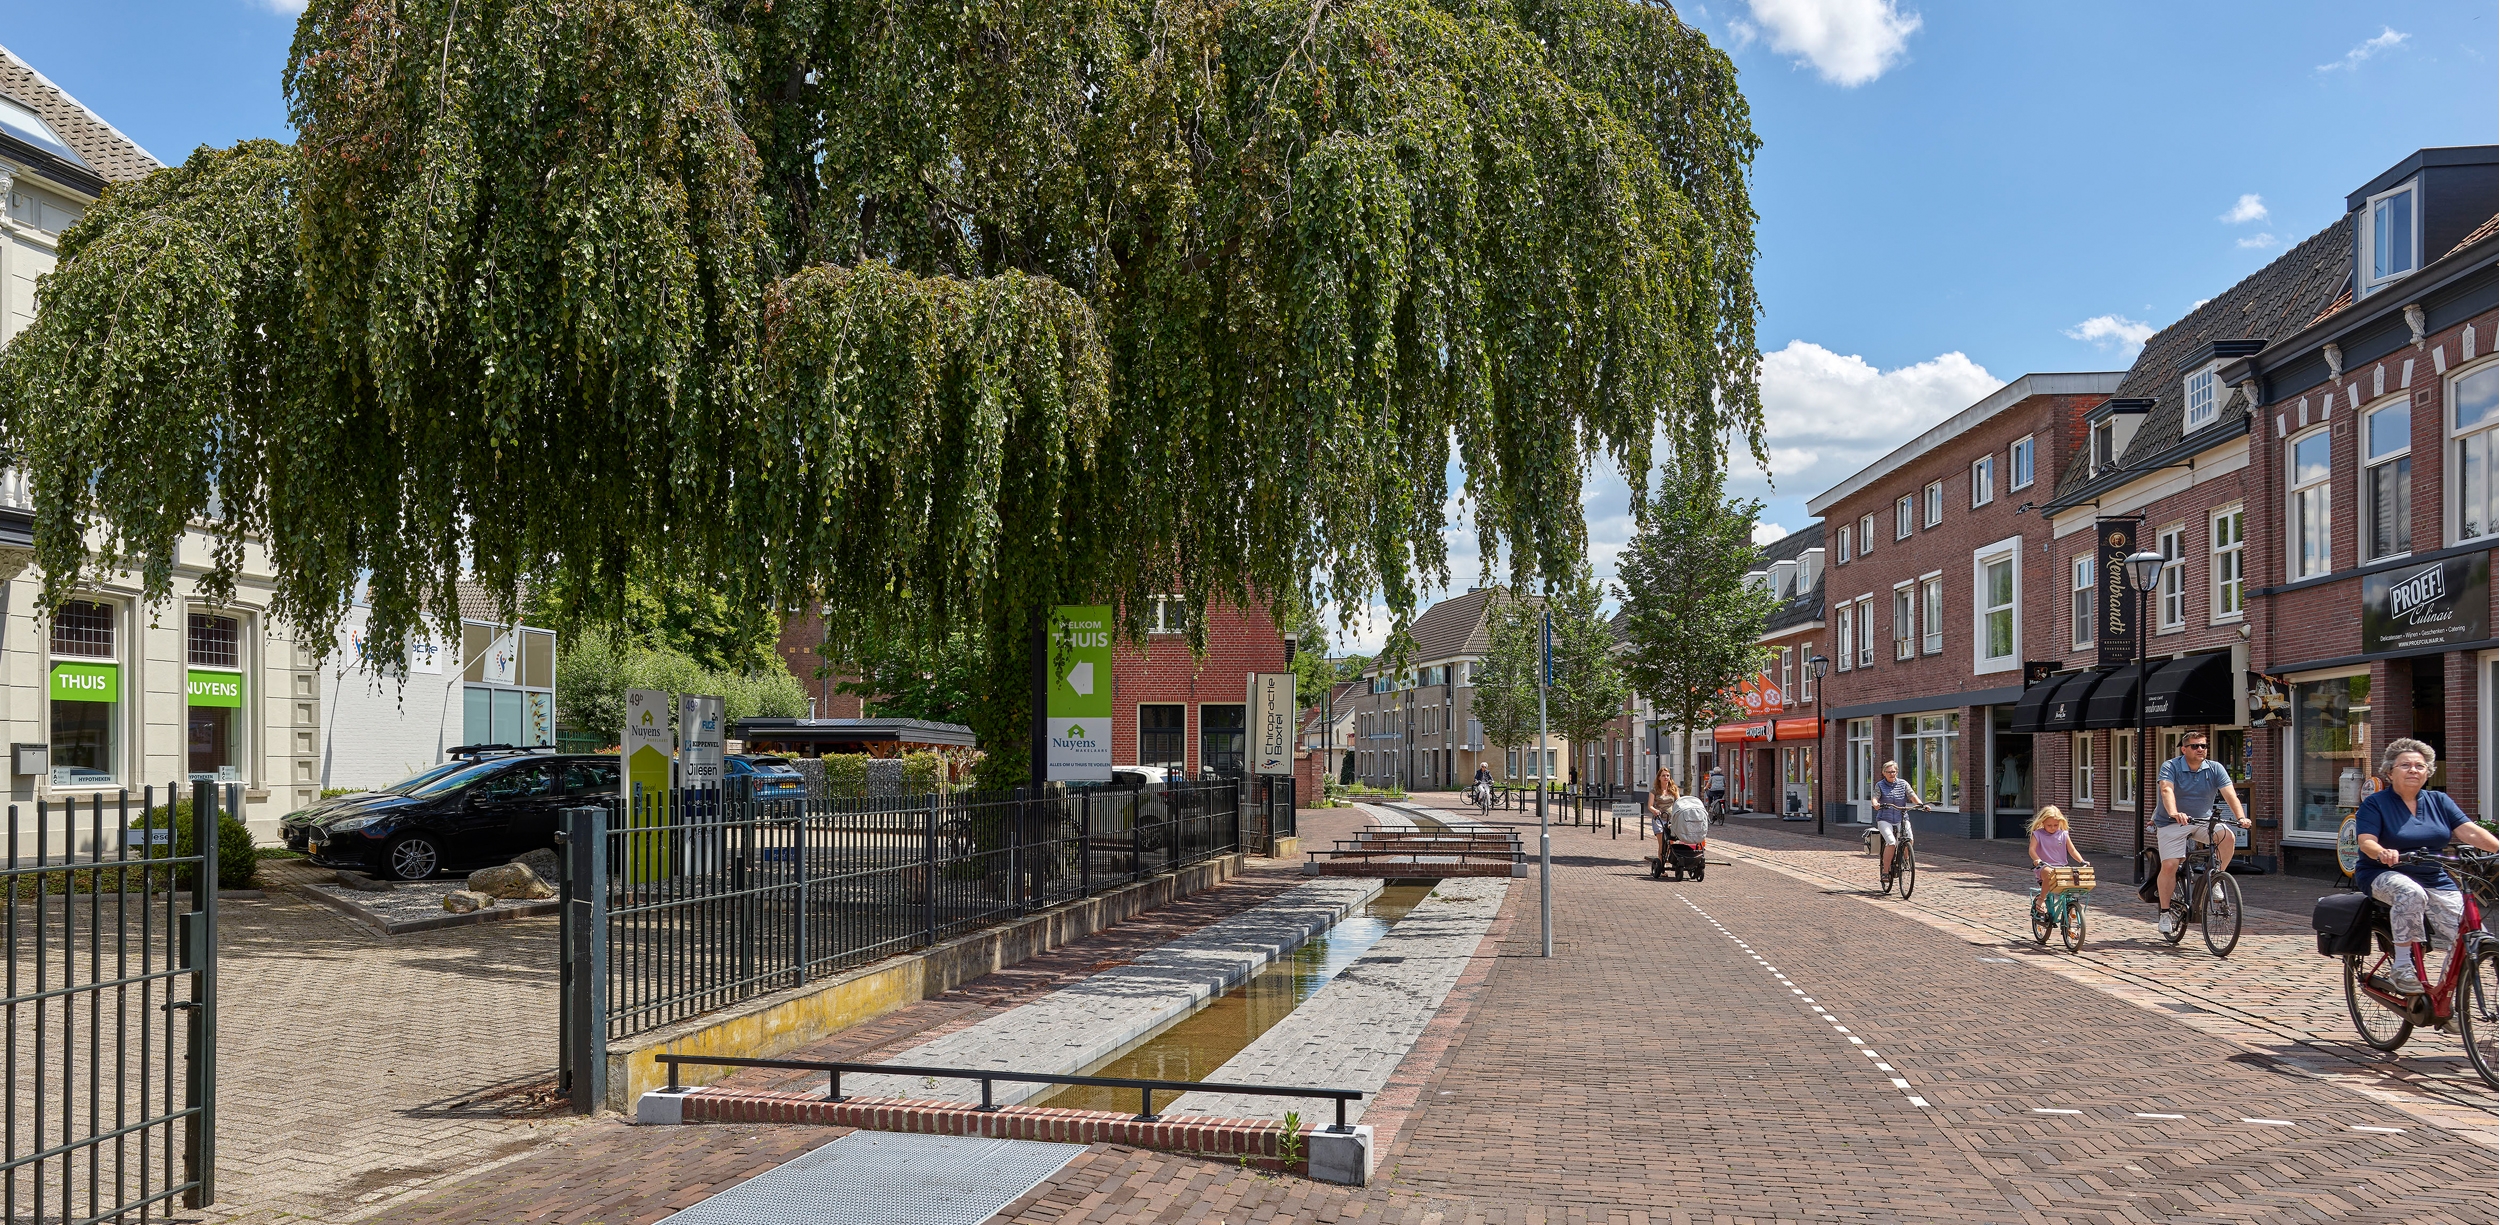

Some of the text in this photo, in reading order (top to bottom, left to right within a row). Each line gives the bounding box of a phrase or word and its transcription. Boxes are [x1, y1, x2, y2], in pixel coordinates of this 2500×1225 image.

[2106, 551, 2127, 635] Rembrandt
[2392, 569, 2442, 614] PROEF!
[2410, 603, 2453, 625] Culinair
[2421, 628, 2445, 636] Geschenken
[2448, 625, 2466, 633] Catering
[1052, 632, 1108, 648] THUIS
[2398, 637, 2445, 648] WWW.PROEFCULINAIR.NL
[59, 674, 106, 690] THUIS
[188, 681, 238, 697] NUYENS
[629, 693, 644, 706] 49b
[685, 699, 698, 712] 49b
[1265, 678, 1275, 755] Chiropractie
[632, 725, 661, 739] Nuyens
[1274, 714, 1283, 755] Boxtel
[1746, 726, 1766, 738] expert
[1052, 738, 1096, 750] Nuyens
[687, 763, 718, 776] Jilesen
